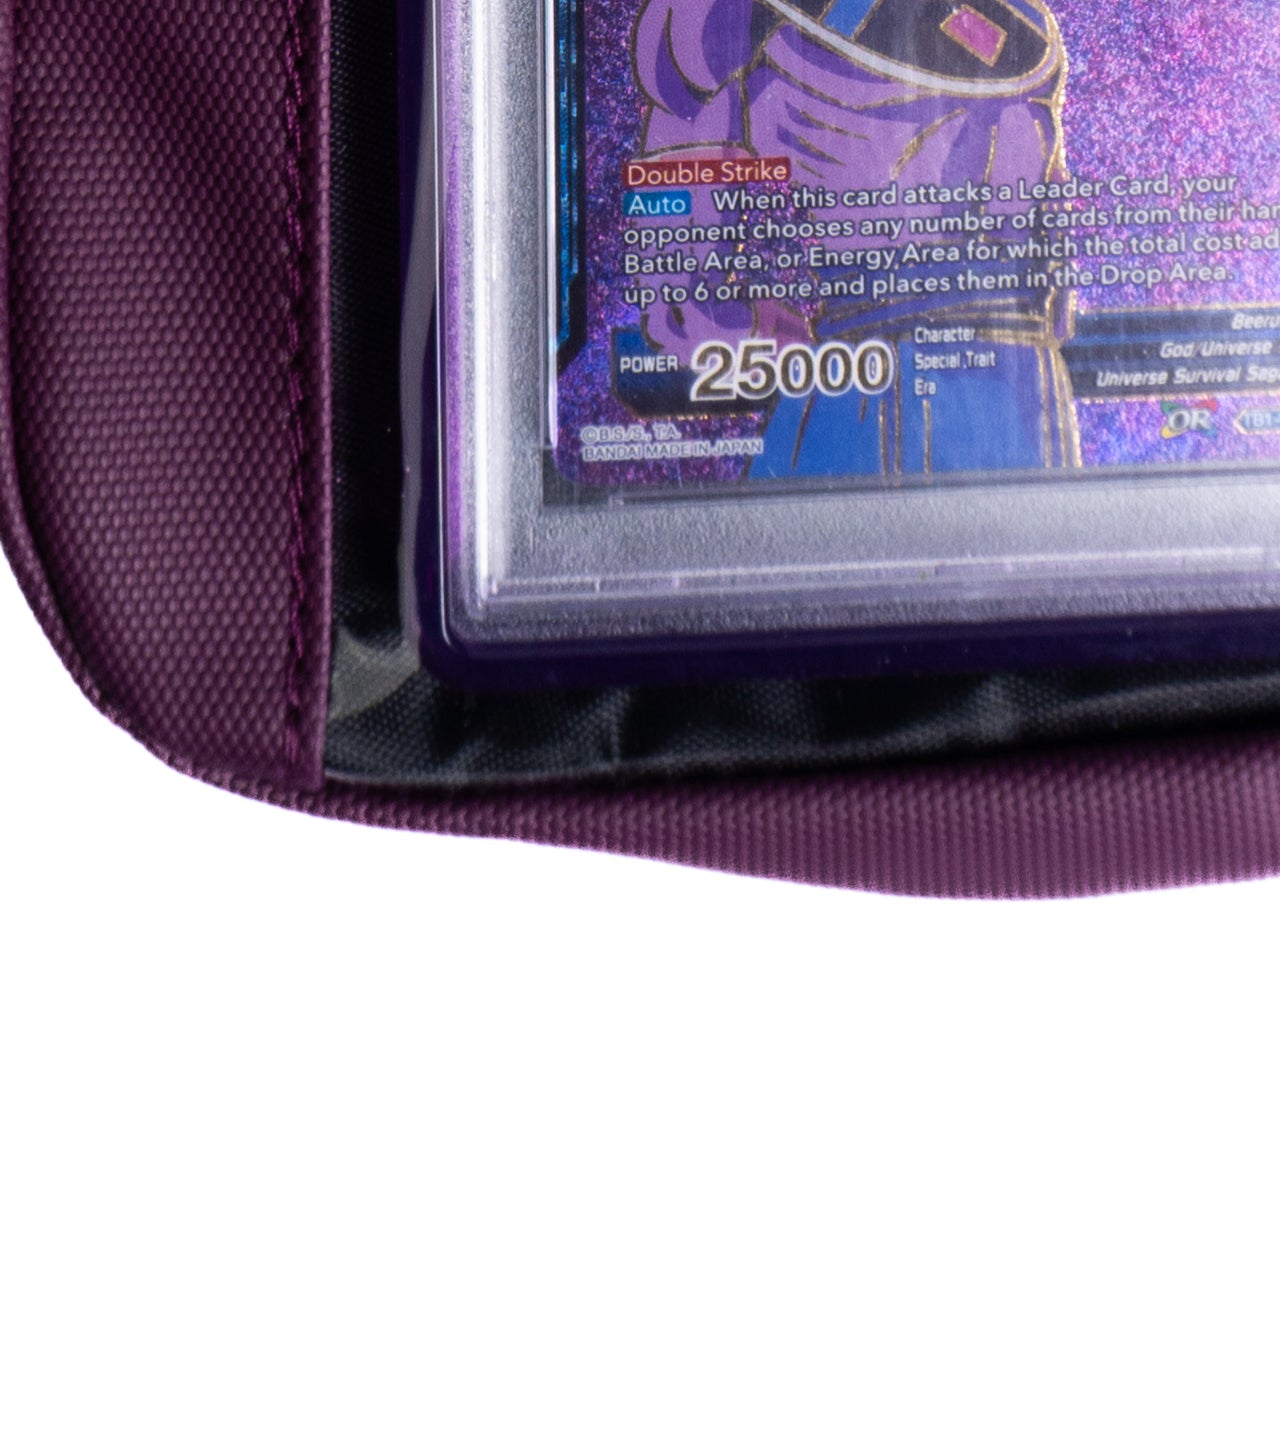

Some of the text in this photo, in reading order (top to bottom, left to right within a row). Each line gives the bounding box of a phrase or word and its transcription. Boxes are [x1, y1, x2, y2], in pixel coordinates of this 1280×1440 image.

[628, 160, 788, 186] Double Strike
[628, 174, 1237, 215] Auto When this card attacks a Leader Card, your
[624, 222, 746, 248] opponent
[752, 217, 854, 240] chooses
[860, 217, 903, 240] any
[909, 211, 1004, 234] number
[1011, 208, 1037, 230] of
[1042, 204, 1109, 228] cards
[1114, 203, 1172, 225] from
[1178, 200, 1236, 223] their
[624, 251, 698, 274] Battle
[704, 249, 770, 272] Area,
[777, 252, 802, 269] or
[809, 245, 896, 270] Energy
[901, 243, 960, 264] Area
[966, 239, 1001, 261] for
[1006, 236, 1078, 260] which
[1084, 234, 1124, 256] the
[1130, 232, 1186, 254] total
[1193, 233, 1245, 253] cost
[624, 259, 1234, 308] up to 6 or more and places them in the Drop Area.
[914, 326, 976, 344] Character
[1160, 337, 1273, 359] God/Universe
[620, 339, 895, 402] POWER 25000
[915, 350, 997, 370] Special Trait
[915, 379, 936, 396] Era
[1096, 370, 1168, 388] Universe
[1173, 366, 1241, 384] Survival
[1169, 409, 1212, 430] OR
[583, 439, 763, 461] BANDAI MADE IN JAPAN
